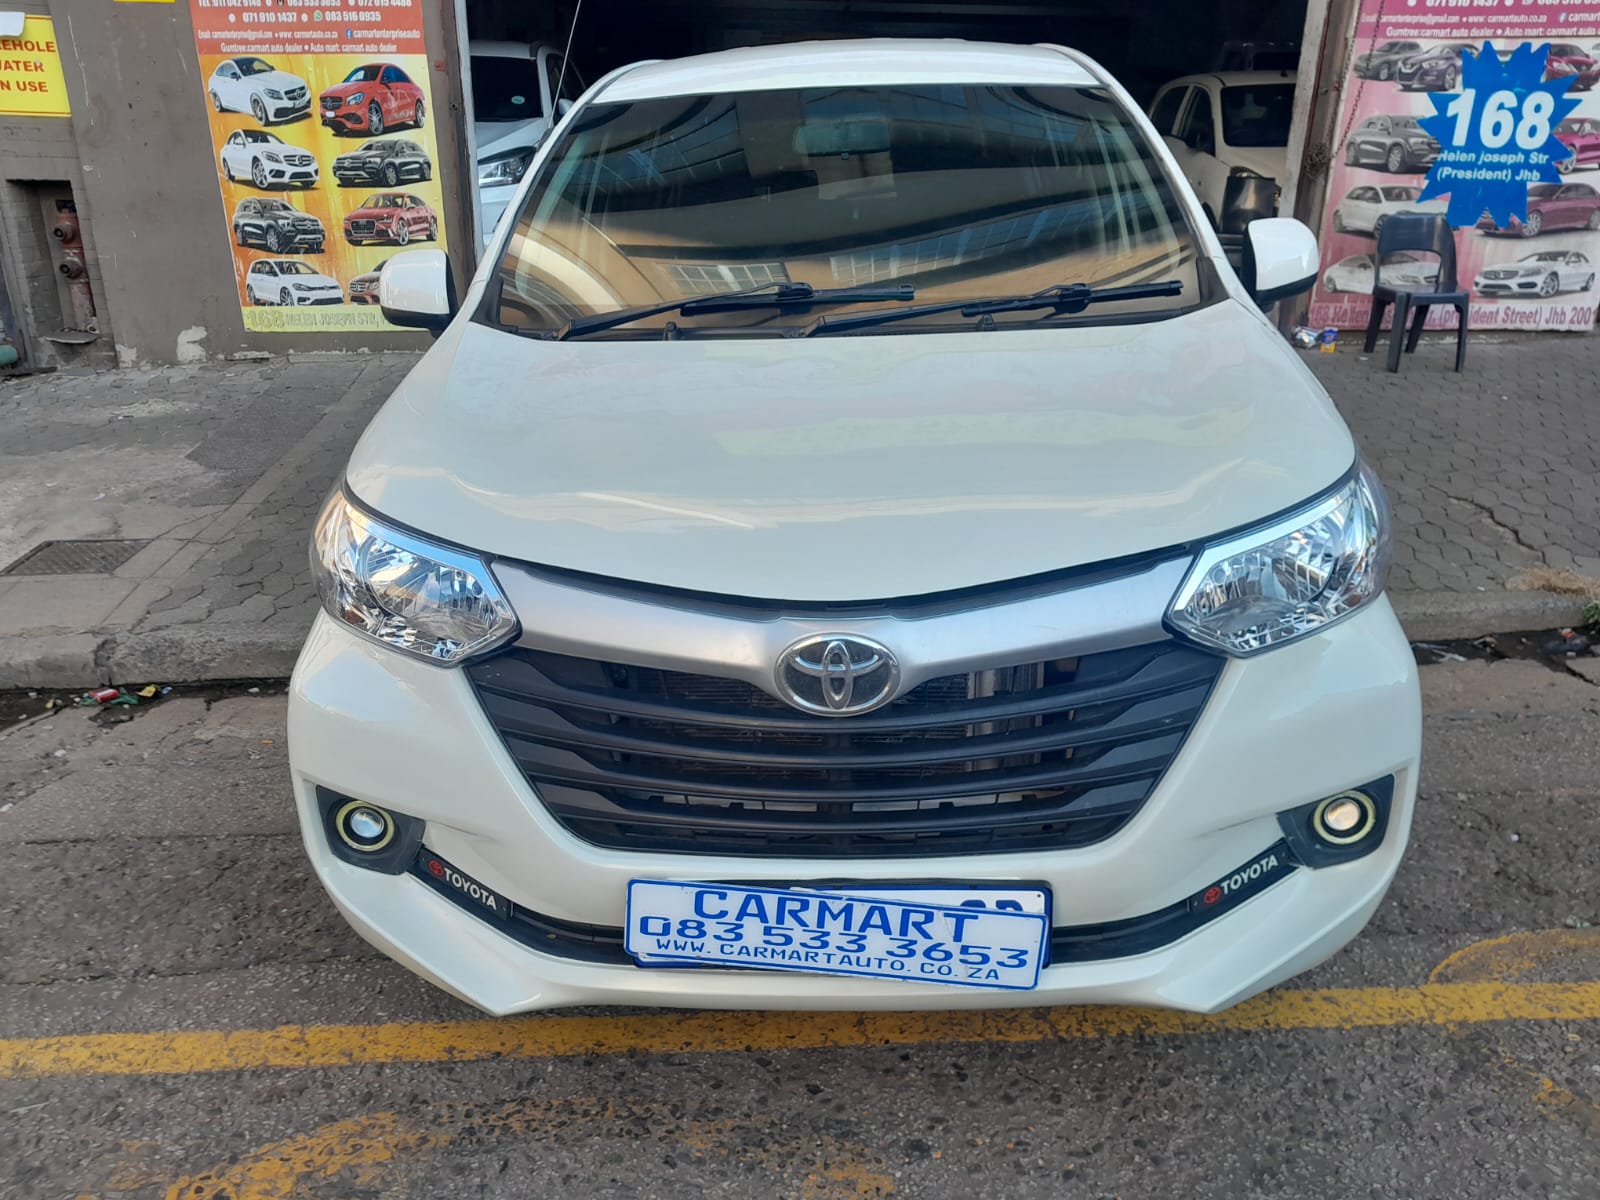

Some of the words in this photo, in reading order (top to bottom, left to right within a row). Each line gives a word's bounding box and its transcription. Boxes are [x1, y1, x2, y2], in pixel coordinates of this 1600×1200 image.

[242, 12, 258, 22] 071
[258, 12, 276, 22] 910
[276, 12, 297, 22] 1437
[325, 11, 342, 21] 083
[343, 11, 359, 21] 516
[359, 11, 382, 21] 0935
[1451, 28, 1469, 37] auto
[1503, 27, 1524, 37] Auto
[1546, 27, 1578, 37] carmart
[1578, 27, 1596, 36] auto
[0, 39, 56, 53] EHOLE
[310, 43, 325, 52] Auto
[341, 43, 364, 52] carmart
[0, 60, 45, 72] ATER
[16, 81, 49, 92] USE
[1447, 88, 1554, 150] 168
[1437, 150, 1476, 163] Helen
[1478, 151, 1525, 165] joseph
[1529, 151, 1549, 164] Str
[1436, 167, 1512, 182] (President)
[1515, 168, 1541, 182] Jhb
[1502, 306, 1543, 329] Street)
[1545, 306, 1566, 325] Jhb
[1220, 853, 1279, 895] TOYOTA
[443, 867, 497, 910] TOYOTA
[692, 889, 979, 944] CARMART
[639, 915, 745, 943] 083
[762, 926, 868, 954] 533
[886, 937, 1030, 969] 3653
